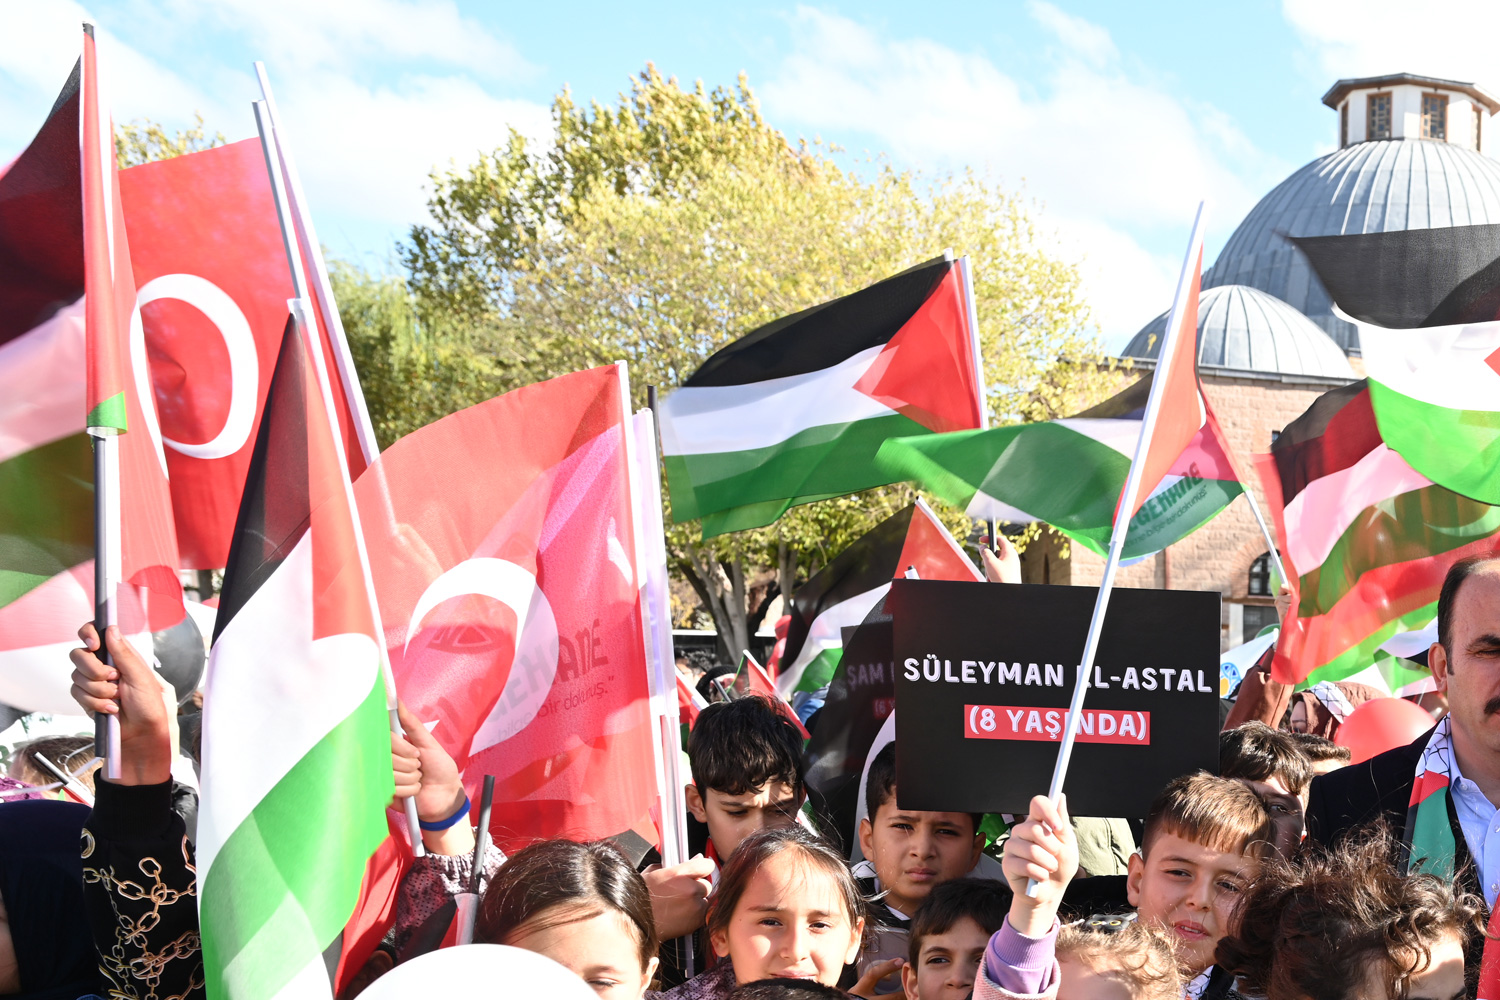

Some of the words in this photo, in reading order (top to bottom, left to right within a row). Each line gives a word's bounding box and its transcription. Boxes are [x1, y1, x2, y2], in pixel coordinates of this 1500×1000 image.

[903, 654, 1064, 688] SÜLEYMAN
[969, 705, 997, 734] (8
[1006, 708, 1147, 740] YAŞNDA)
